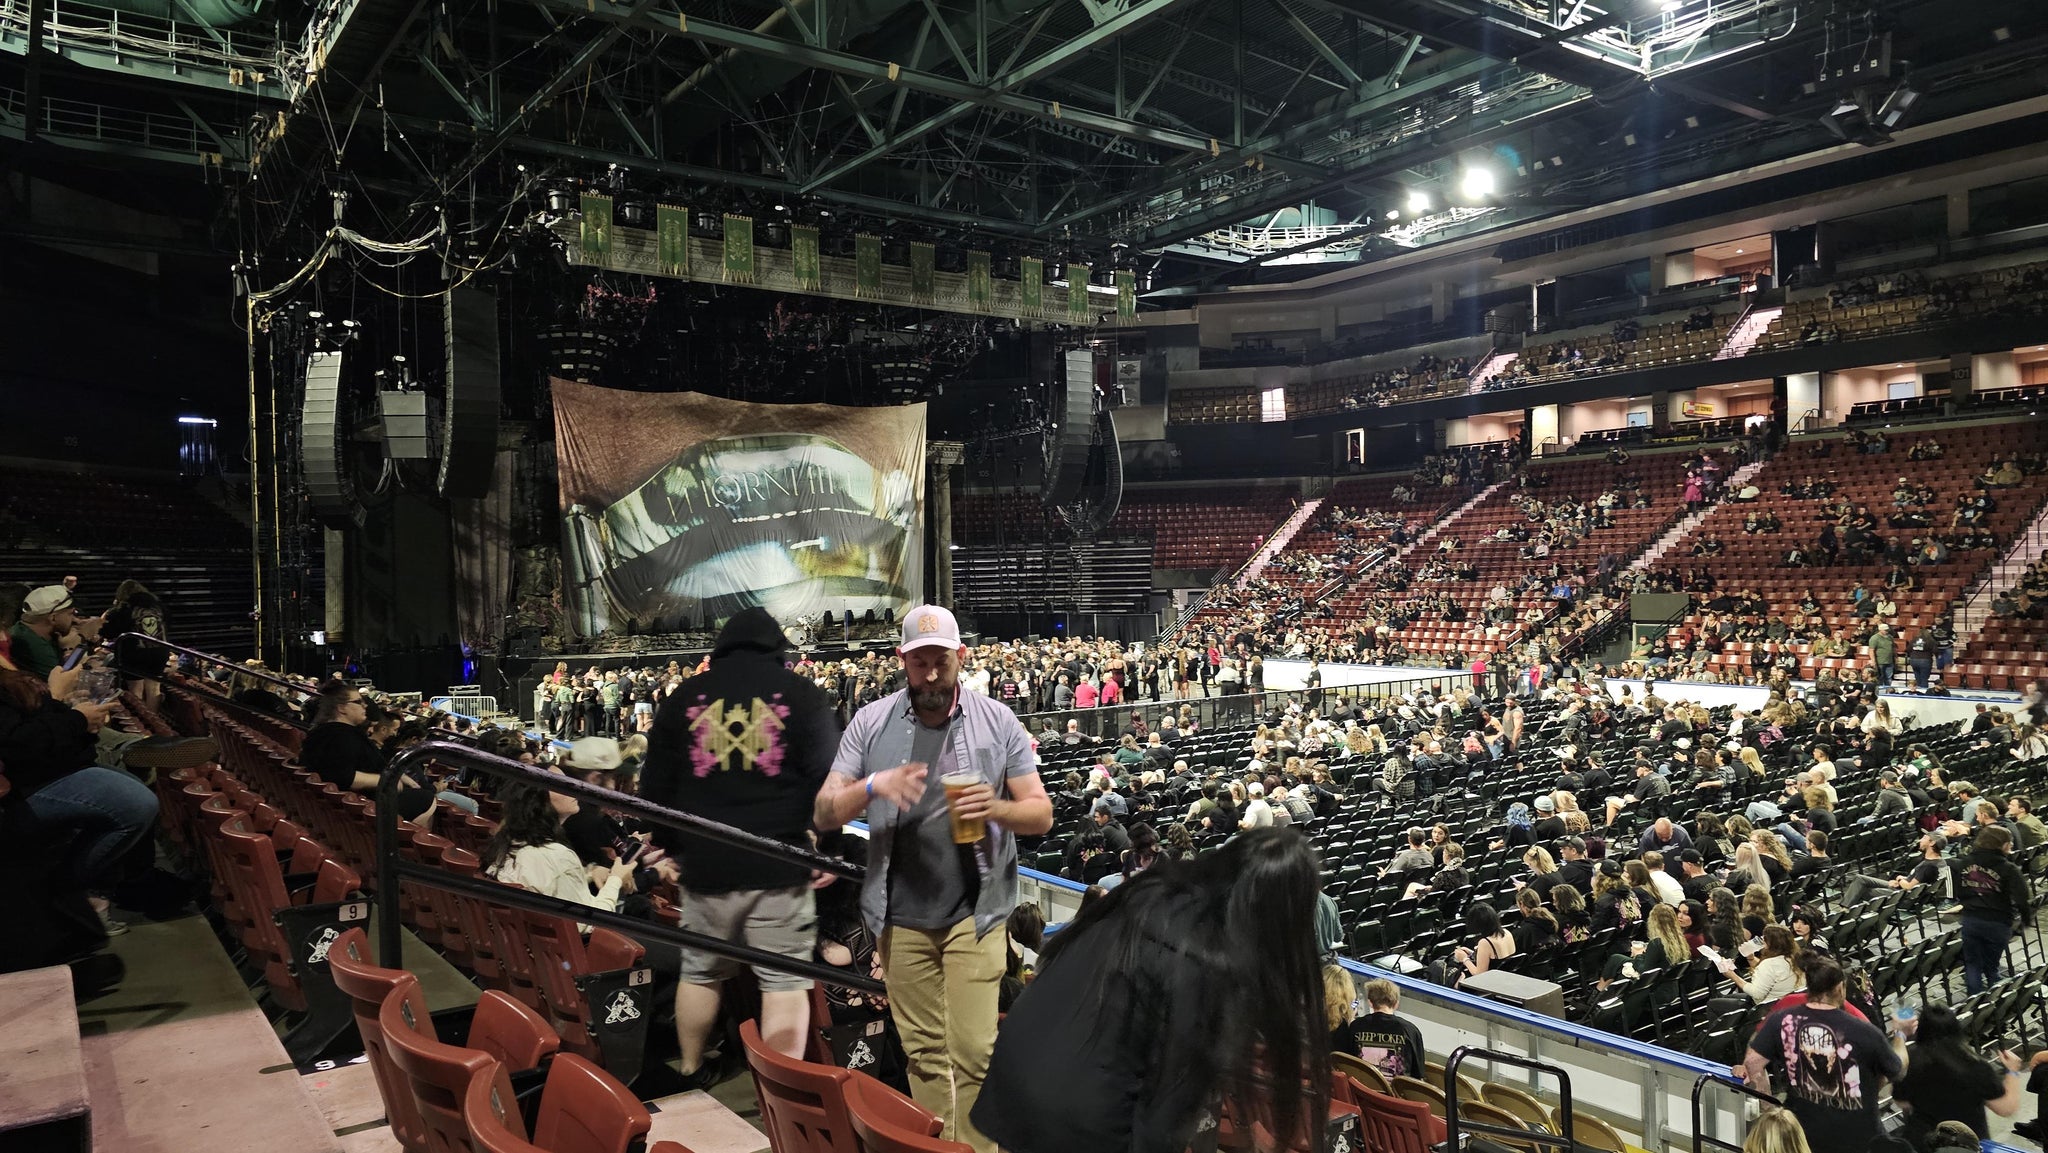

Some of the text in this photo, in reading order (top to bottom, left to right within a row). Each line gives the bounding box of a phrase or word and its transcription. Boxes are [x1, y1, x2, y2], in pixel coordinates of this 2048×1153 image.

[1952, 368, 1970, 380] 101
[349, 905, 358, 919] 9
[637, 970, 644, 984] 8
[872, 1022, 878, 1034] 7
[1354, 1031, 1406, 1045] SLEEP TOKEN
